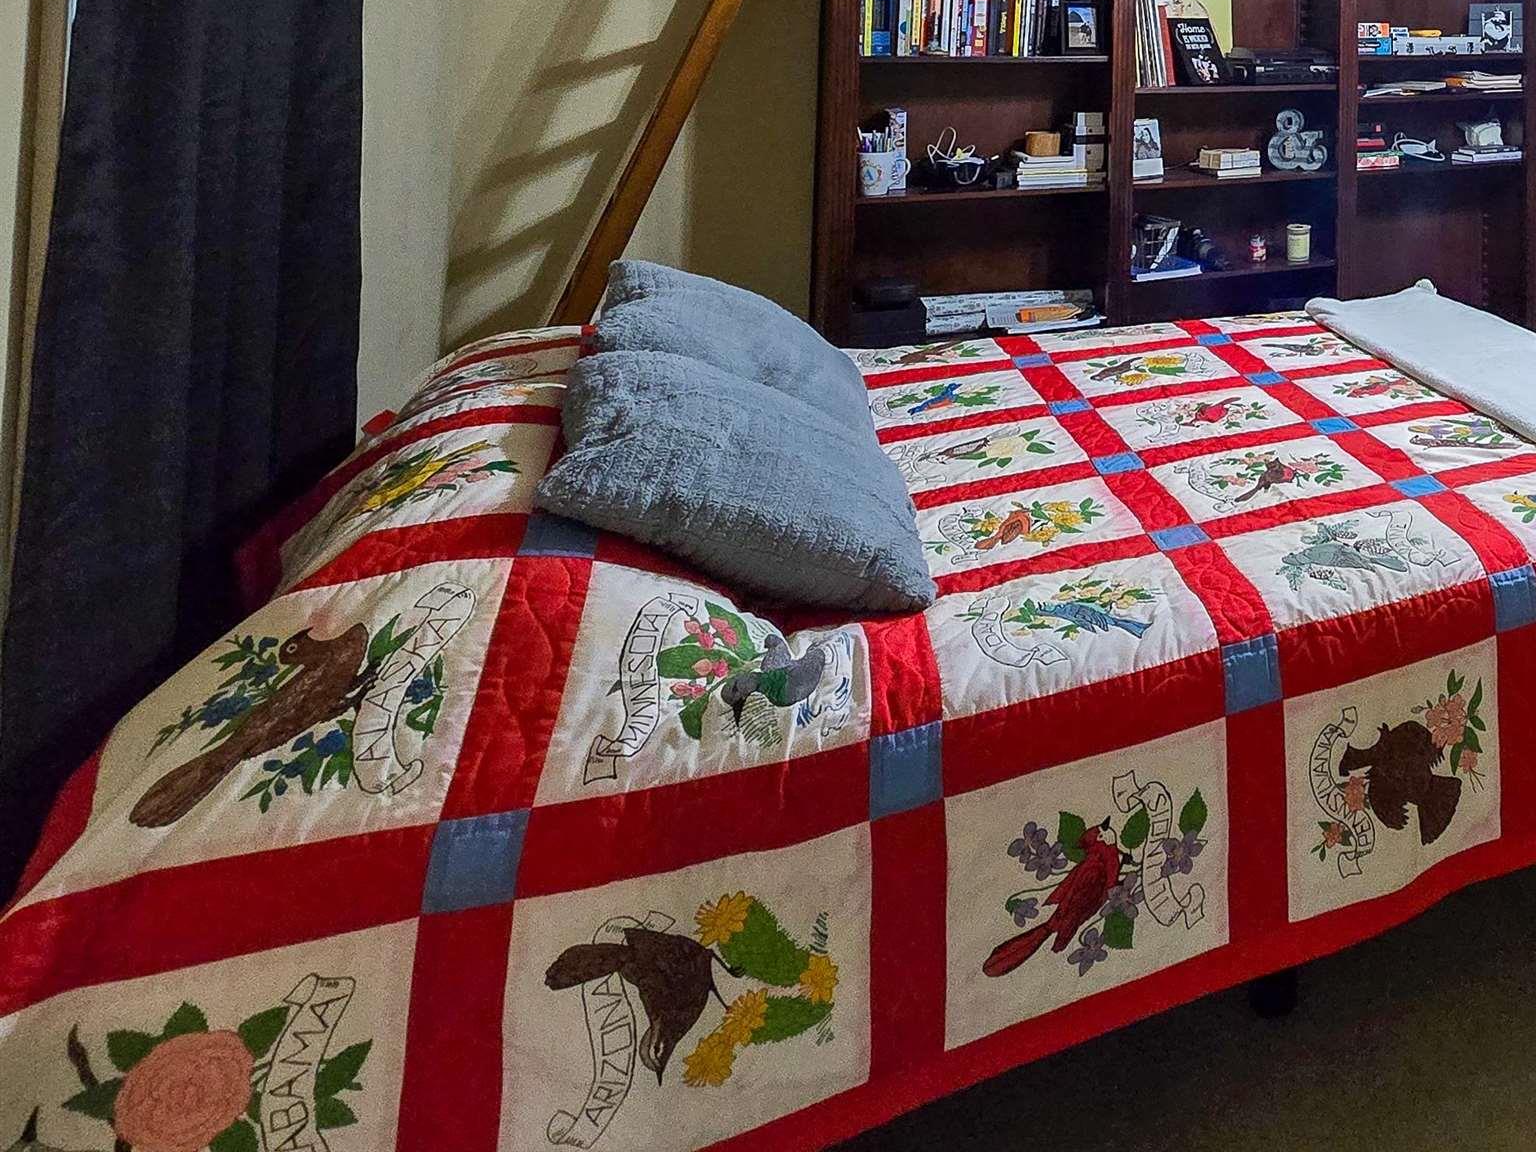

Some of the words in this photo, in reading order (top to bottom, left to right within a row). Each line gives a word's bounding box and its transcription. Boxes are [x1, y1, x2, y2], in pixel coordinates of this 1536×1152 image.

[1177, 23, 1206, 33] Home
[355, 617, 461, 762] ALASKA
[616, 612, 669, 750] MINNESOTA
[1312, 725, 1372, 847] PENNSYLVANIA
[585, 971, 633, 1127] ARIZONA
